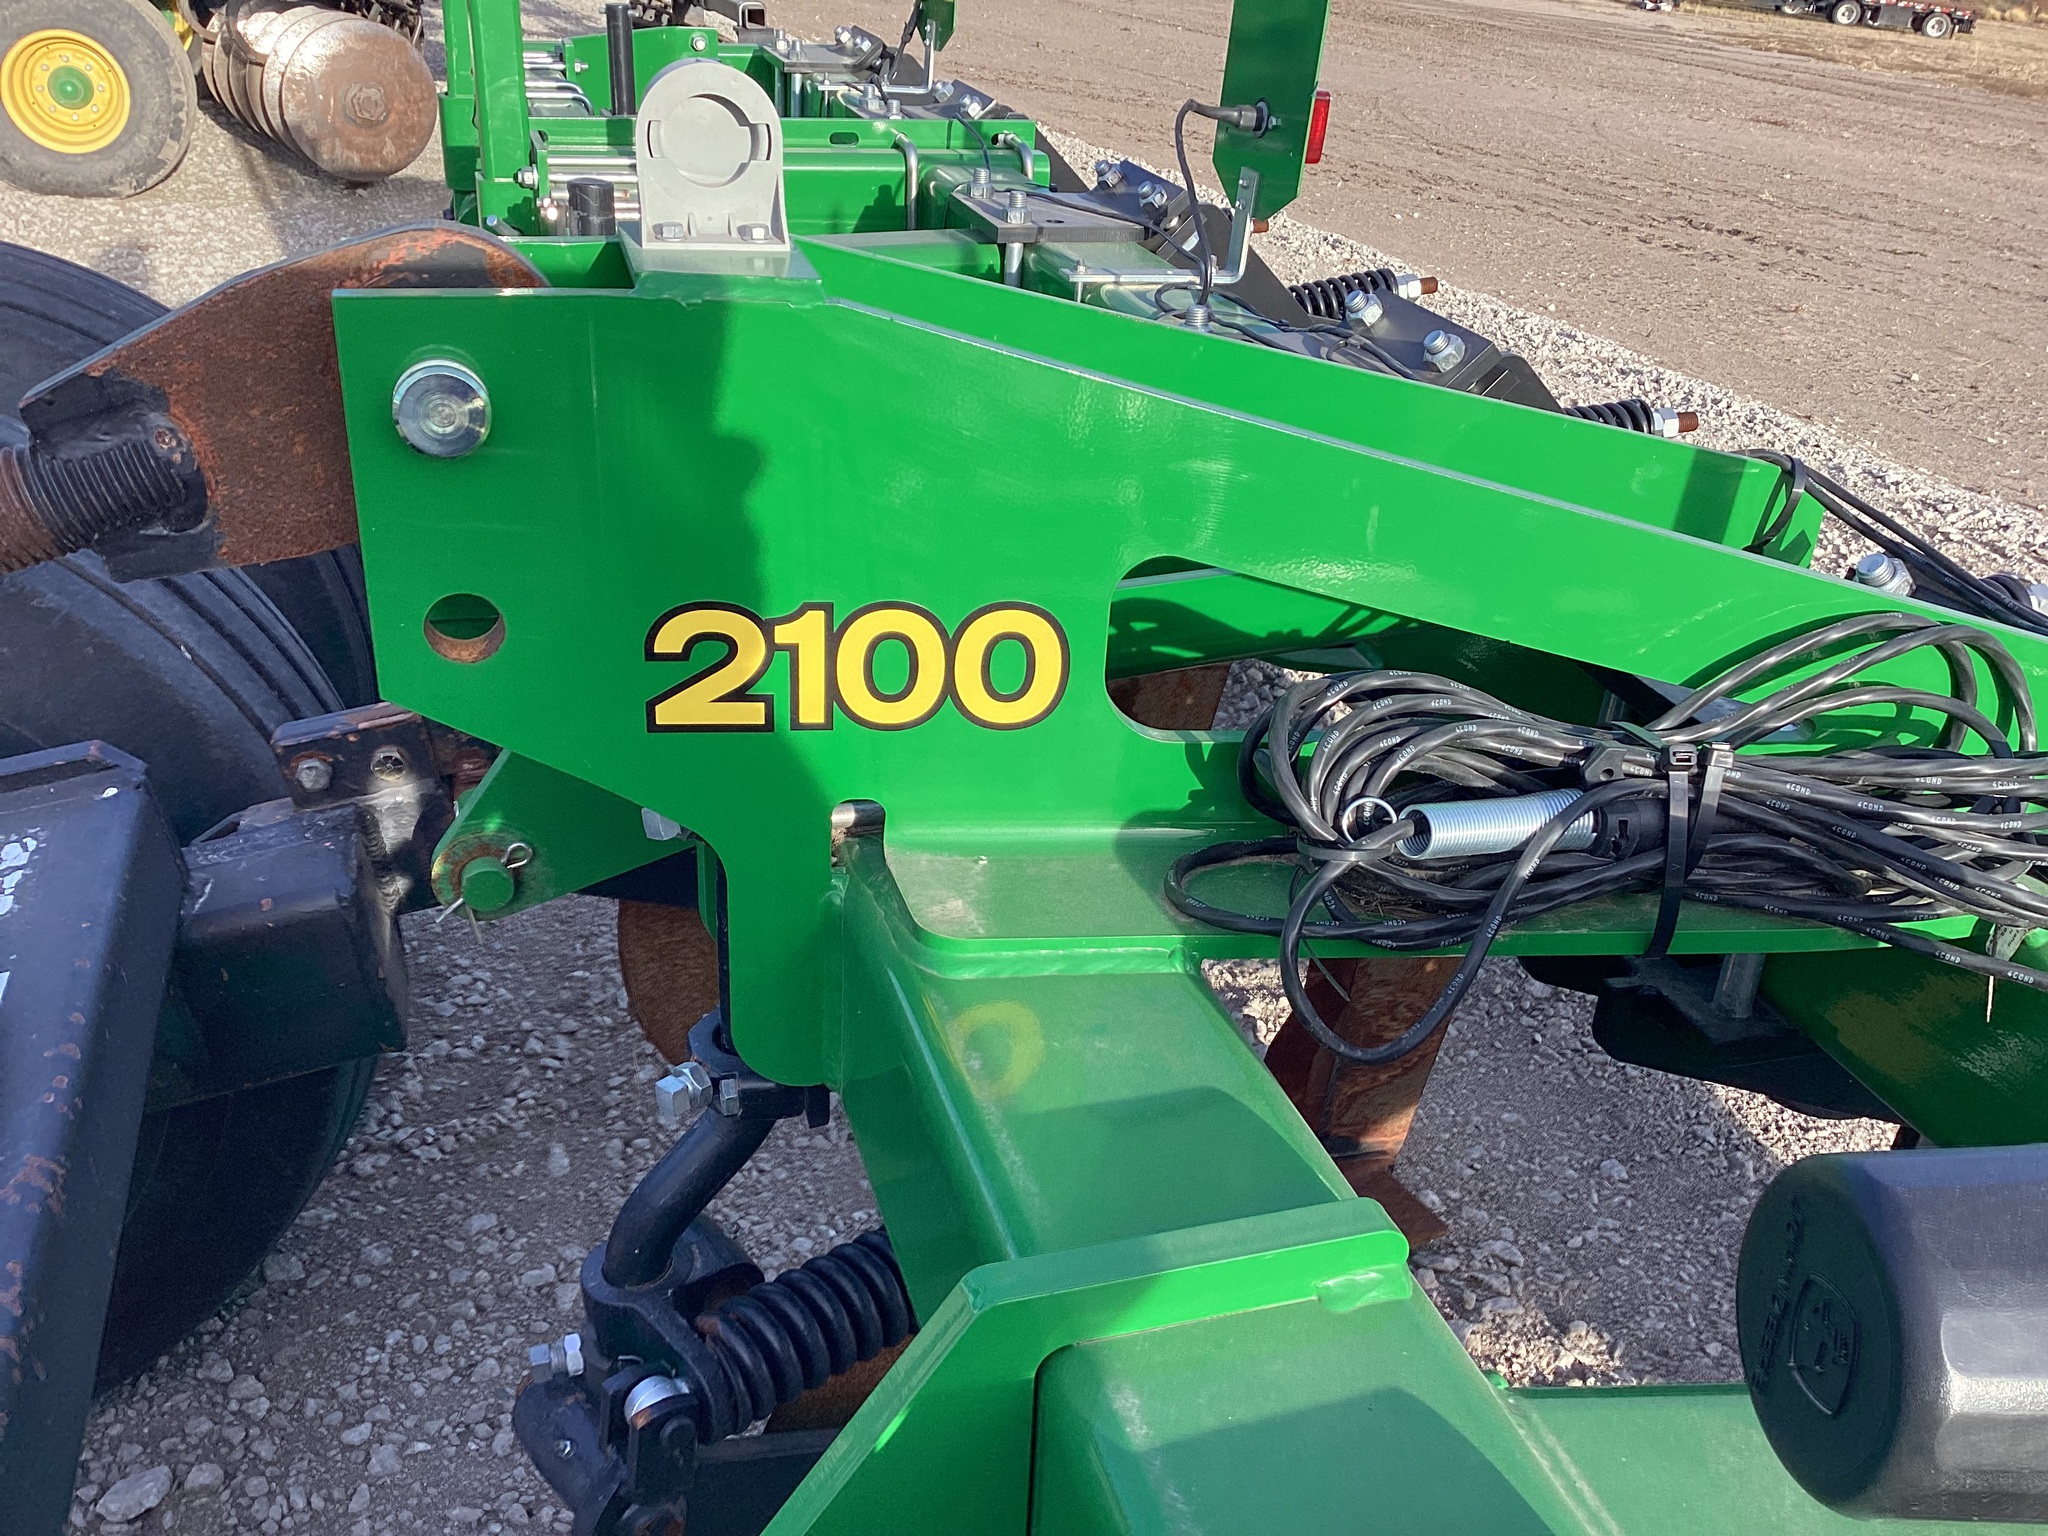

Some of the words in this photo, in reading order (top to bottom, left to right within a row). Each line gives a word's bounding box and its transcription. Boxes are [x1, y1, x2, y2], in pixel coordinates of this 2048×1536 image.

[645, 601, 1070, 732] 2100
[1327, 681, 1348, 697] 4COND
[1373, 698, 1392, 710] 4COND
[1455, 724, 1477, 732] 4COND
[1517, 726, 1540, 738] 4COND
[1288, 731, 1300, 752] COND
[1323, 730, 1339, 752] 4COND
[1379, 736, 1400, 747] 4COND
[1396, 745, 1416, 763] 4COND
[1501, 744, 1523, 756] 4COND
[1333, 773, 1348, 795] 4COND
[1786, 782, 1811, 795] 4COND
[1992, 781, 2019, 789] 4COND
[1765, 799, 1791, 811] 4COND
[1857, 801, 1884, 812] 4COND
[2000, 821, 2022, 829] 4COND
[1832, 825, 1857, 839] 4COND
[1957, 841, 1982, 853] 4COND
[1901, 857, 1927, 870] 4COND
[1934, 876, 1960, 891] 4COND
[1695, 891, 1719, 902] 4COND
[1764, 903, 1789, 915] 4COND
[1837, 914, 1864, 923] 4COND
[1485, 915, 1503, 938] 4COND
[1866, 926, 1890, 941] 4COND
[1935, 951, 1961, 964] 4COND
[2007, 970, 2034, 984] 4COND
[1448, 974, 1463, 994] 4COND
